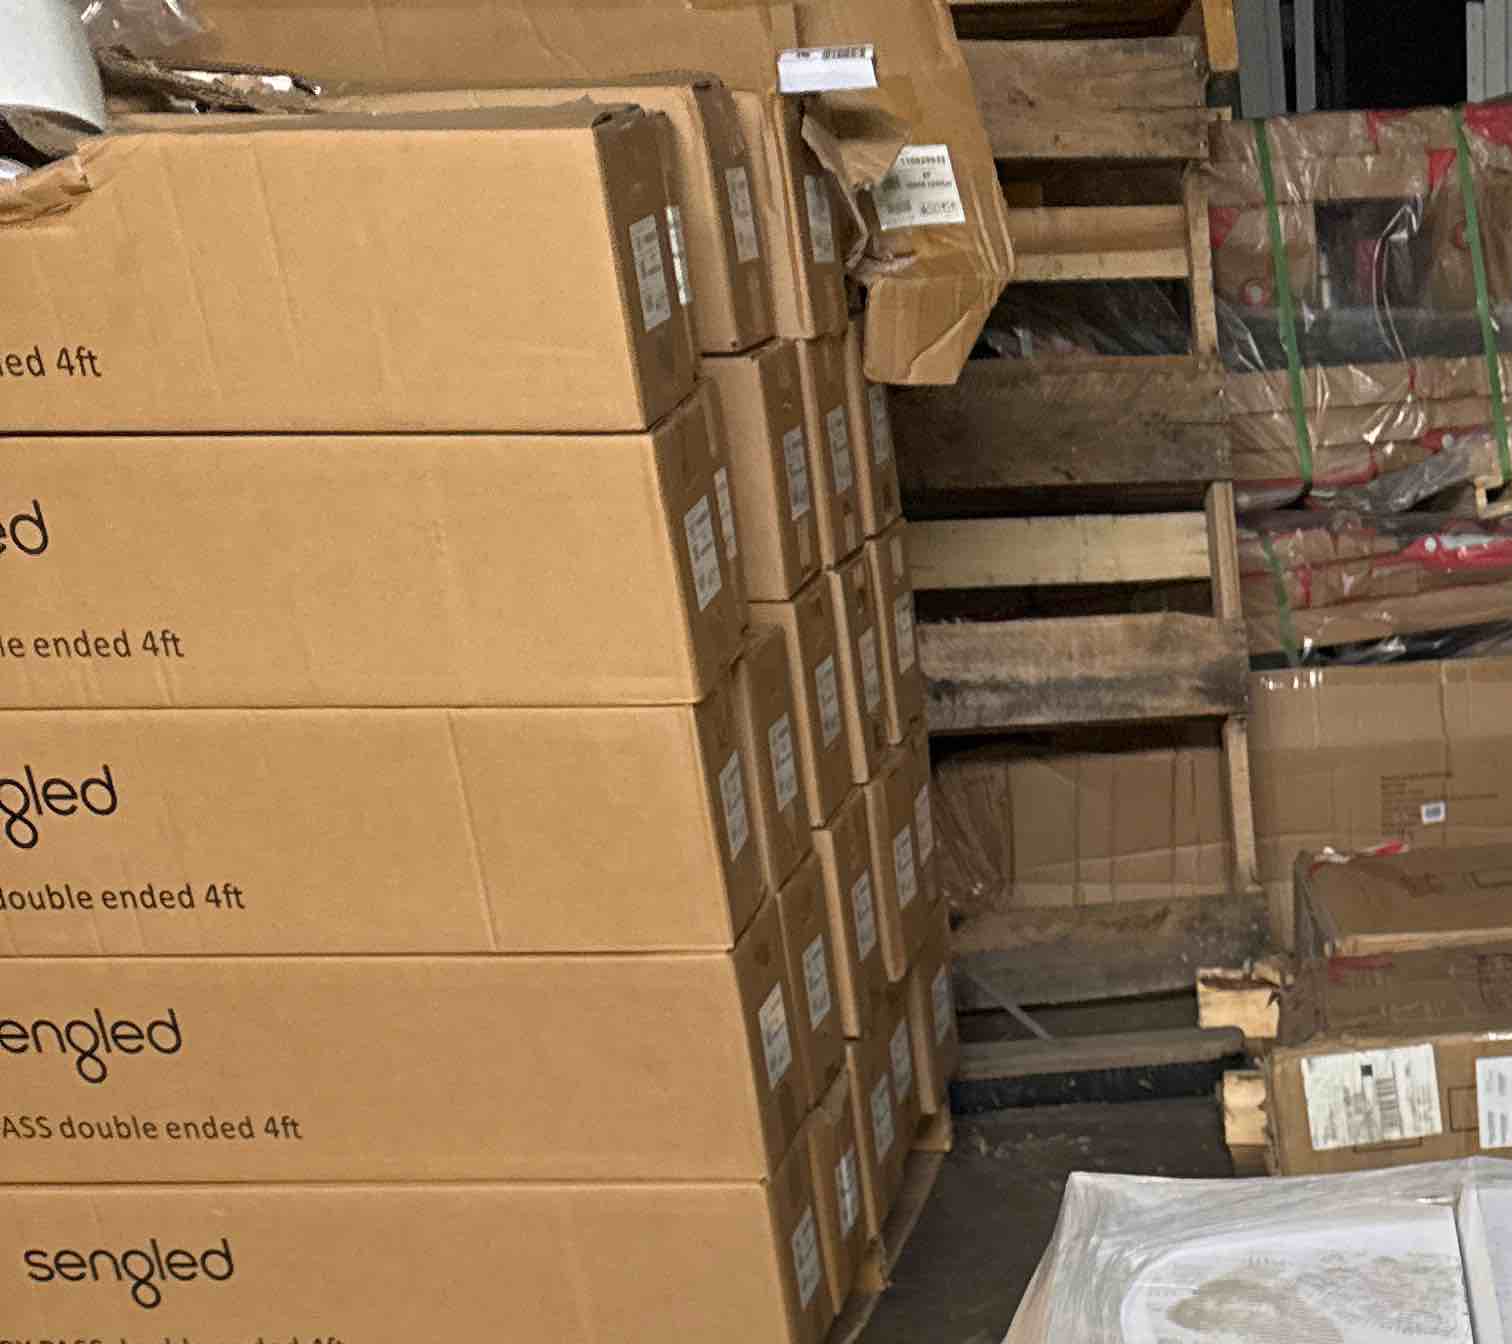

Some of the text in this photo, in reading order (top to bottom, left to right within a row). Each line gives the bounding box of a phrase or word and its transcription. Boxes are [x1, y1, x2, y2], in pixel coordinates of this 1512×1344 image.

[56, 345, 102, 377] 4ft
[33, 628, 131, 658] ended
[142, 628, 185, 658] 4ft
[101, 883, 195, 910] ended
[205, 883, 246, 910] 4ft
[59, 1114, 158, 1140] double
[166, 1114, 256, 1140] ended
[264, 1114, 304, 1140] 4ft
[24, 1238, 234, 1309] sengled
